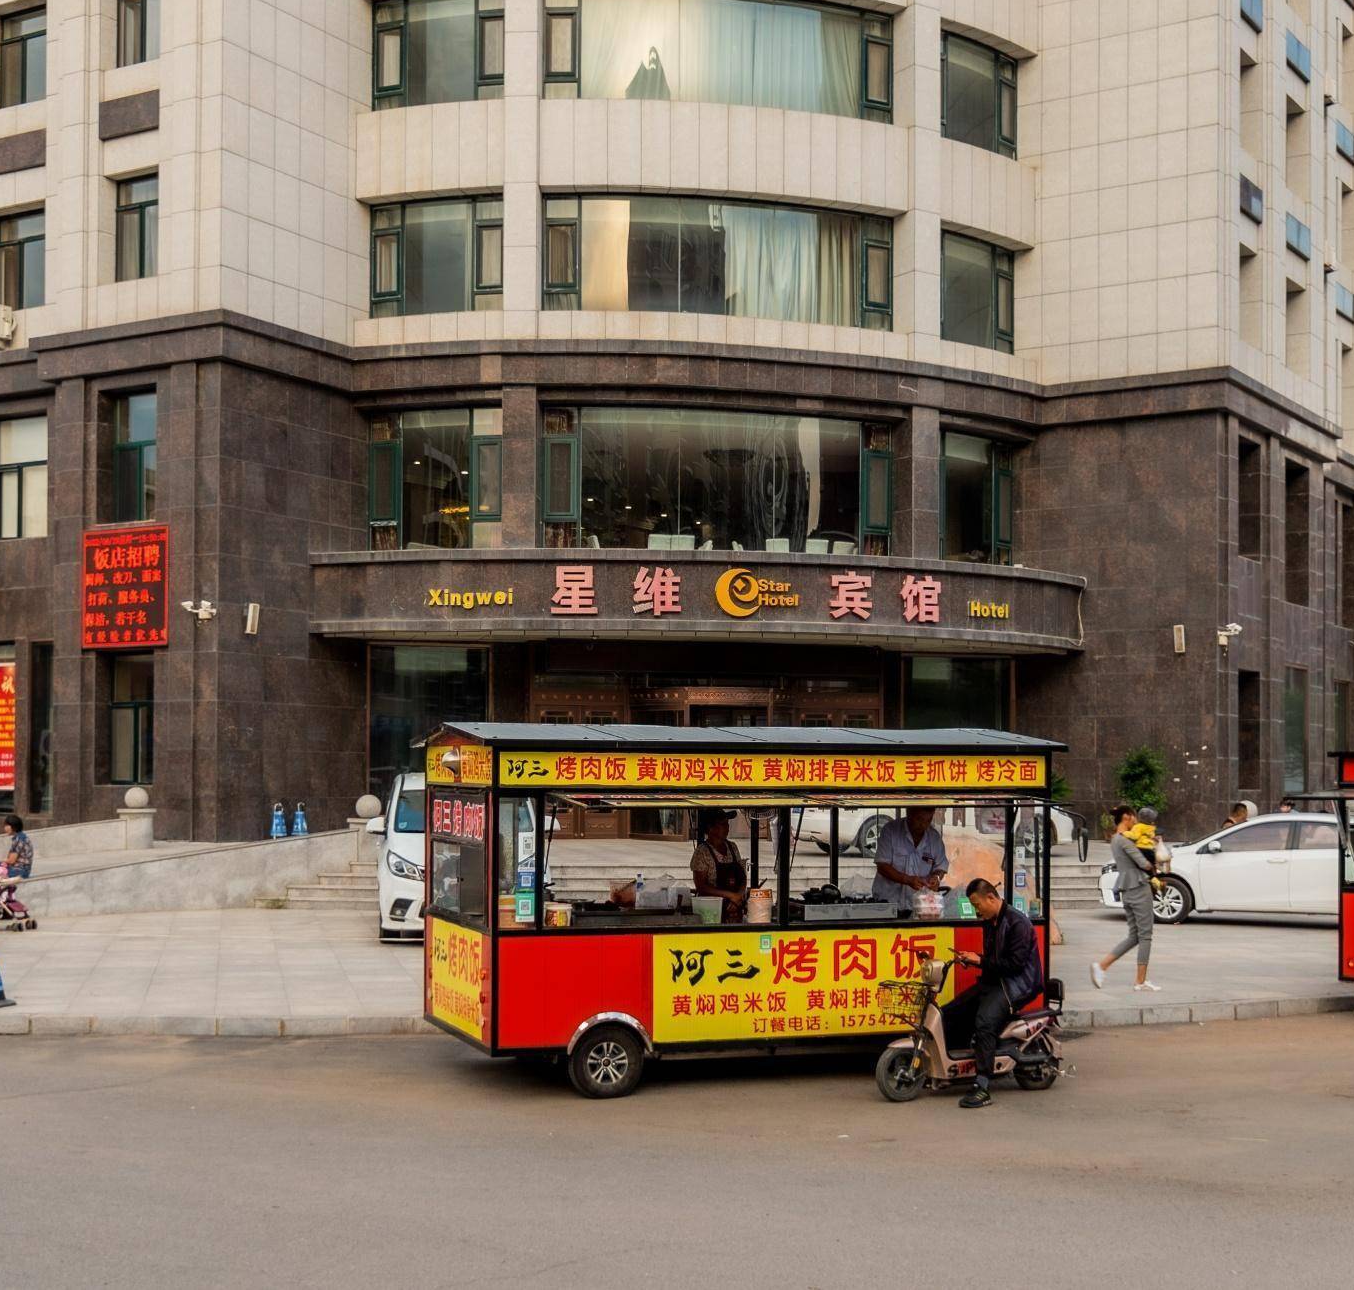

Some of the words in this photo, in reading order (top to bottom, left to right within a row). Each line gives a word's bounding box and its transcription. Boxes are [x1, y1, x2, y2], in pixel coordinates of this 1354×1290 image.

[94, 544, 160, 570] 饭店招聘
[550, 565, 681, 616] 星维
[829, 571, 941, 623] 宾馆
[758, 579, 792, 592] Star
[428, 588, 514, 609] Xingwei
[758, 594, 800, 607] Hotel
[970, 601, 1009, 619] Hotel
[507, 759, 549, 778] 阿三
[555, 757, 626, 781] 烤肉饭
[637, 757, 753, 782] 黄焖鸡米饭
[763, 758, 896, 782] 黄焖排骨米饭
[905, 759, 968, 782] 手抓饼
[977, 760, 1038, 782] 烤冷面
[670, 949, 760, 986] 阿三
[772, 934, 936, 984] 烤肉饭
[672, 991, 787, 1016] 黄焖鸡米饭
